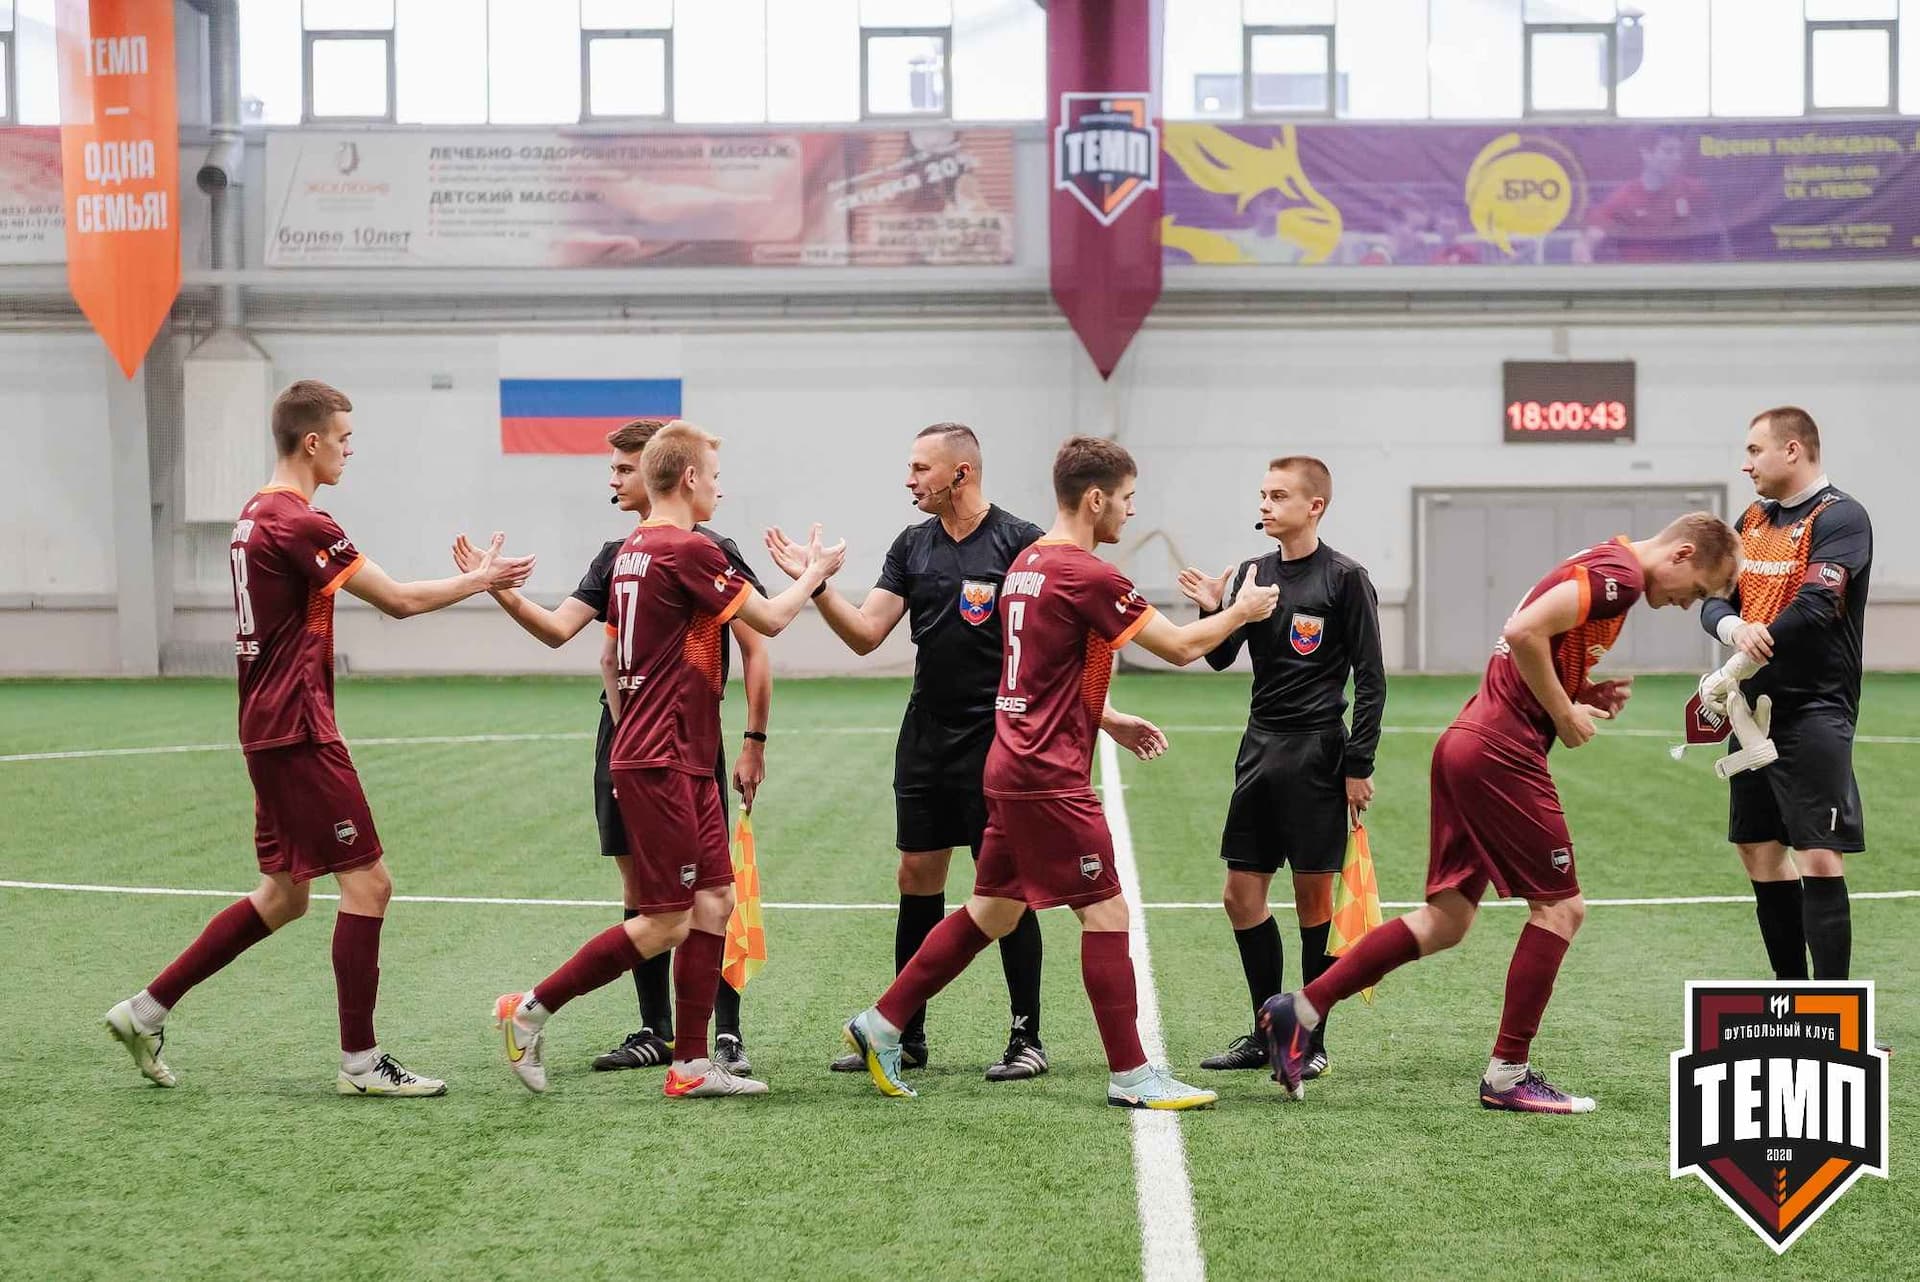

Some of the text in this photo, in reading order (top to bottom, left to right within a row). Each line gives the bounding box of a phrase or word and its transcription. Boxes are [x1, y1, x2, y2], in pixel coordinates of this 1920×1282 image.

[82, 35, 148, 77] ТЕМП
[84, 139, 155, 186] ОДНА
[1064, 128, 1149, 175] ТЕМП
[76, 190, 168, 233] СЕМЬЯ!
[430, 189, 513, 205] ДЕТСКИЙ
[278, 226, 343, 246] более
[1507, 400, 1627, 431] 18:00:43
[614, 580, 639, 670] 17
[1007, 601, 1026, 690] 5
[1830, 807, 1838, 831] 1
